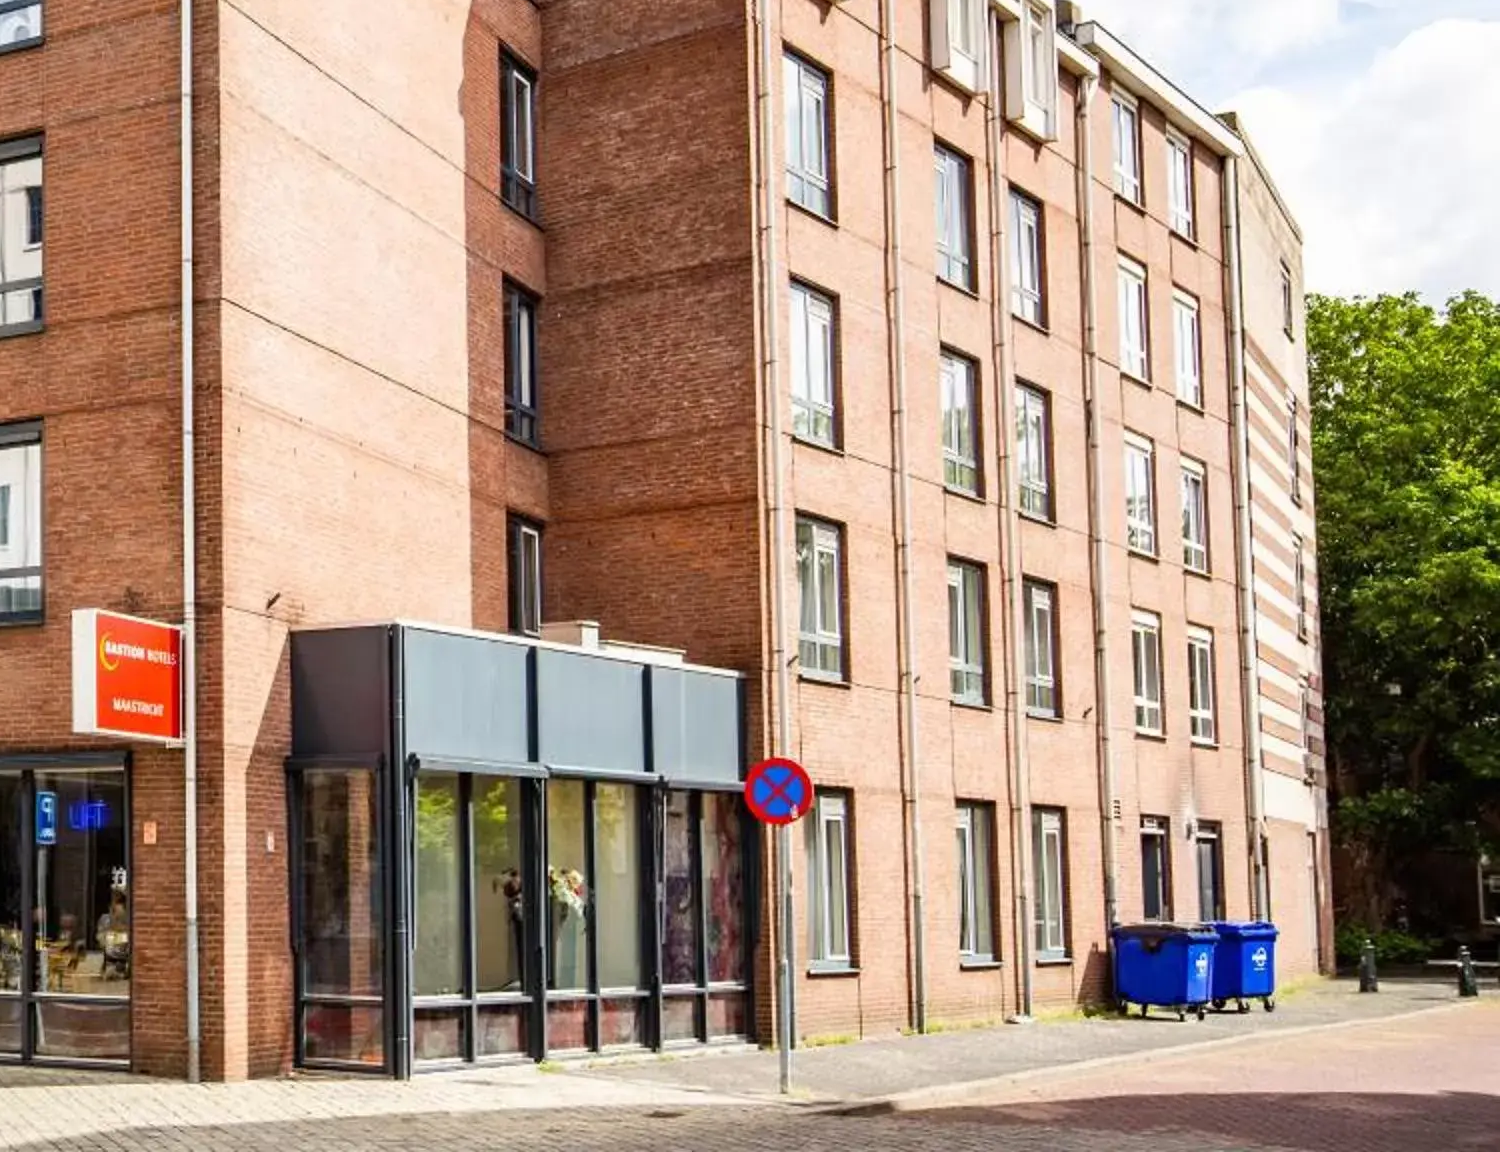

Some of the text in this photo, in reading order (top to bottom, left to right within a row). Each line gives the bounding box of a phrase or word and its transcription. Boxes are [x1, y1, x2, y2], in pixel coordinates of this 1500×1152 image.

[105, 640, 178, 666] BASTION HOTELS
[112, 697, 165, 717] MAASTRICHT
